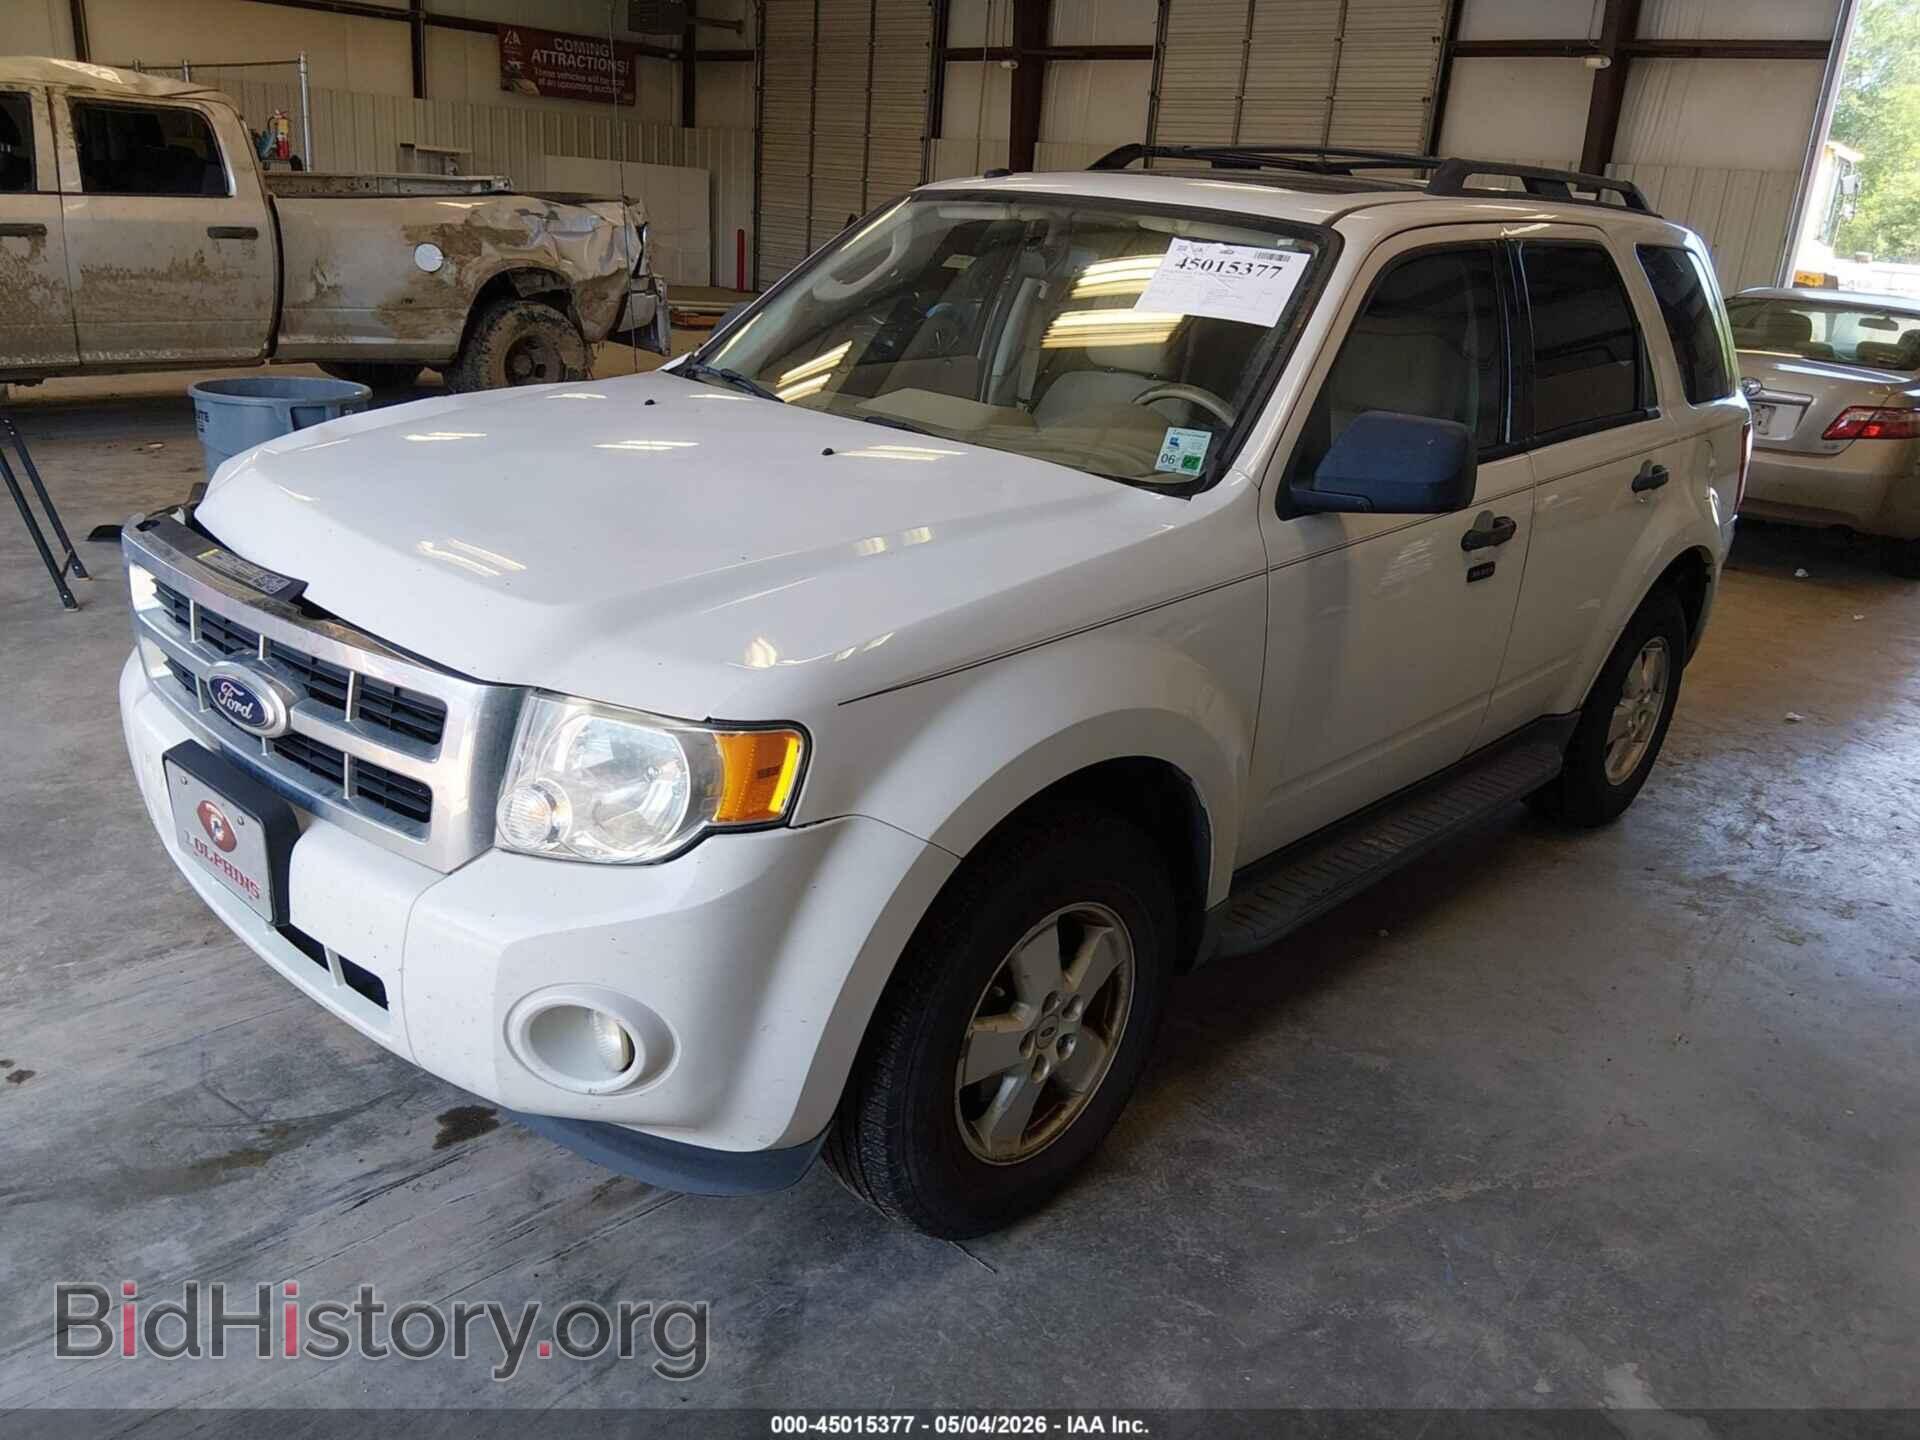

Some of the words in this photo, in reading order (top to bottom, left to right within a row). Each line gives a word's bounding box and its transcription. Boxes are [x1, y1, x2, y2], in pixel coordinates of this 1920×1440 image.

[553, 38, 609, 57] COMING
[531, 49, 630, 74] ATTRACTIONS!
[1174, 256, 1283, 279] 45015377
[1161, 453, 1176, 465] 06
[217, 681, 253, 719] Ford
